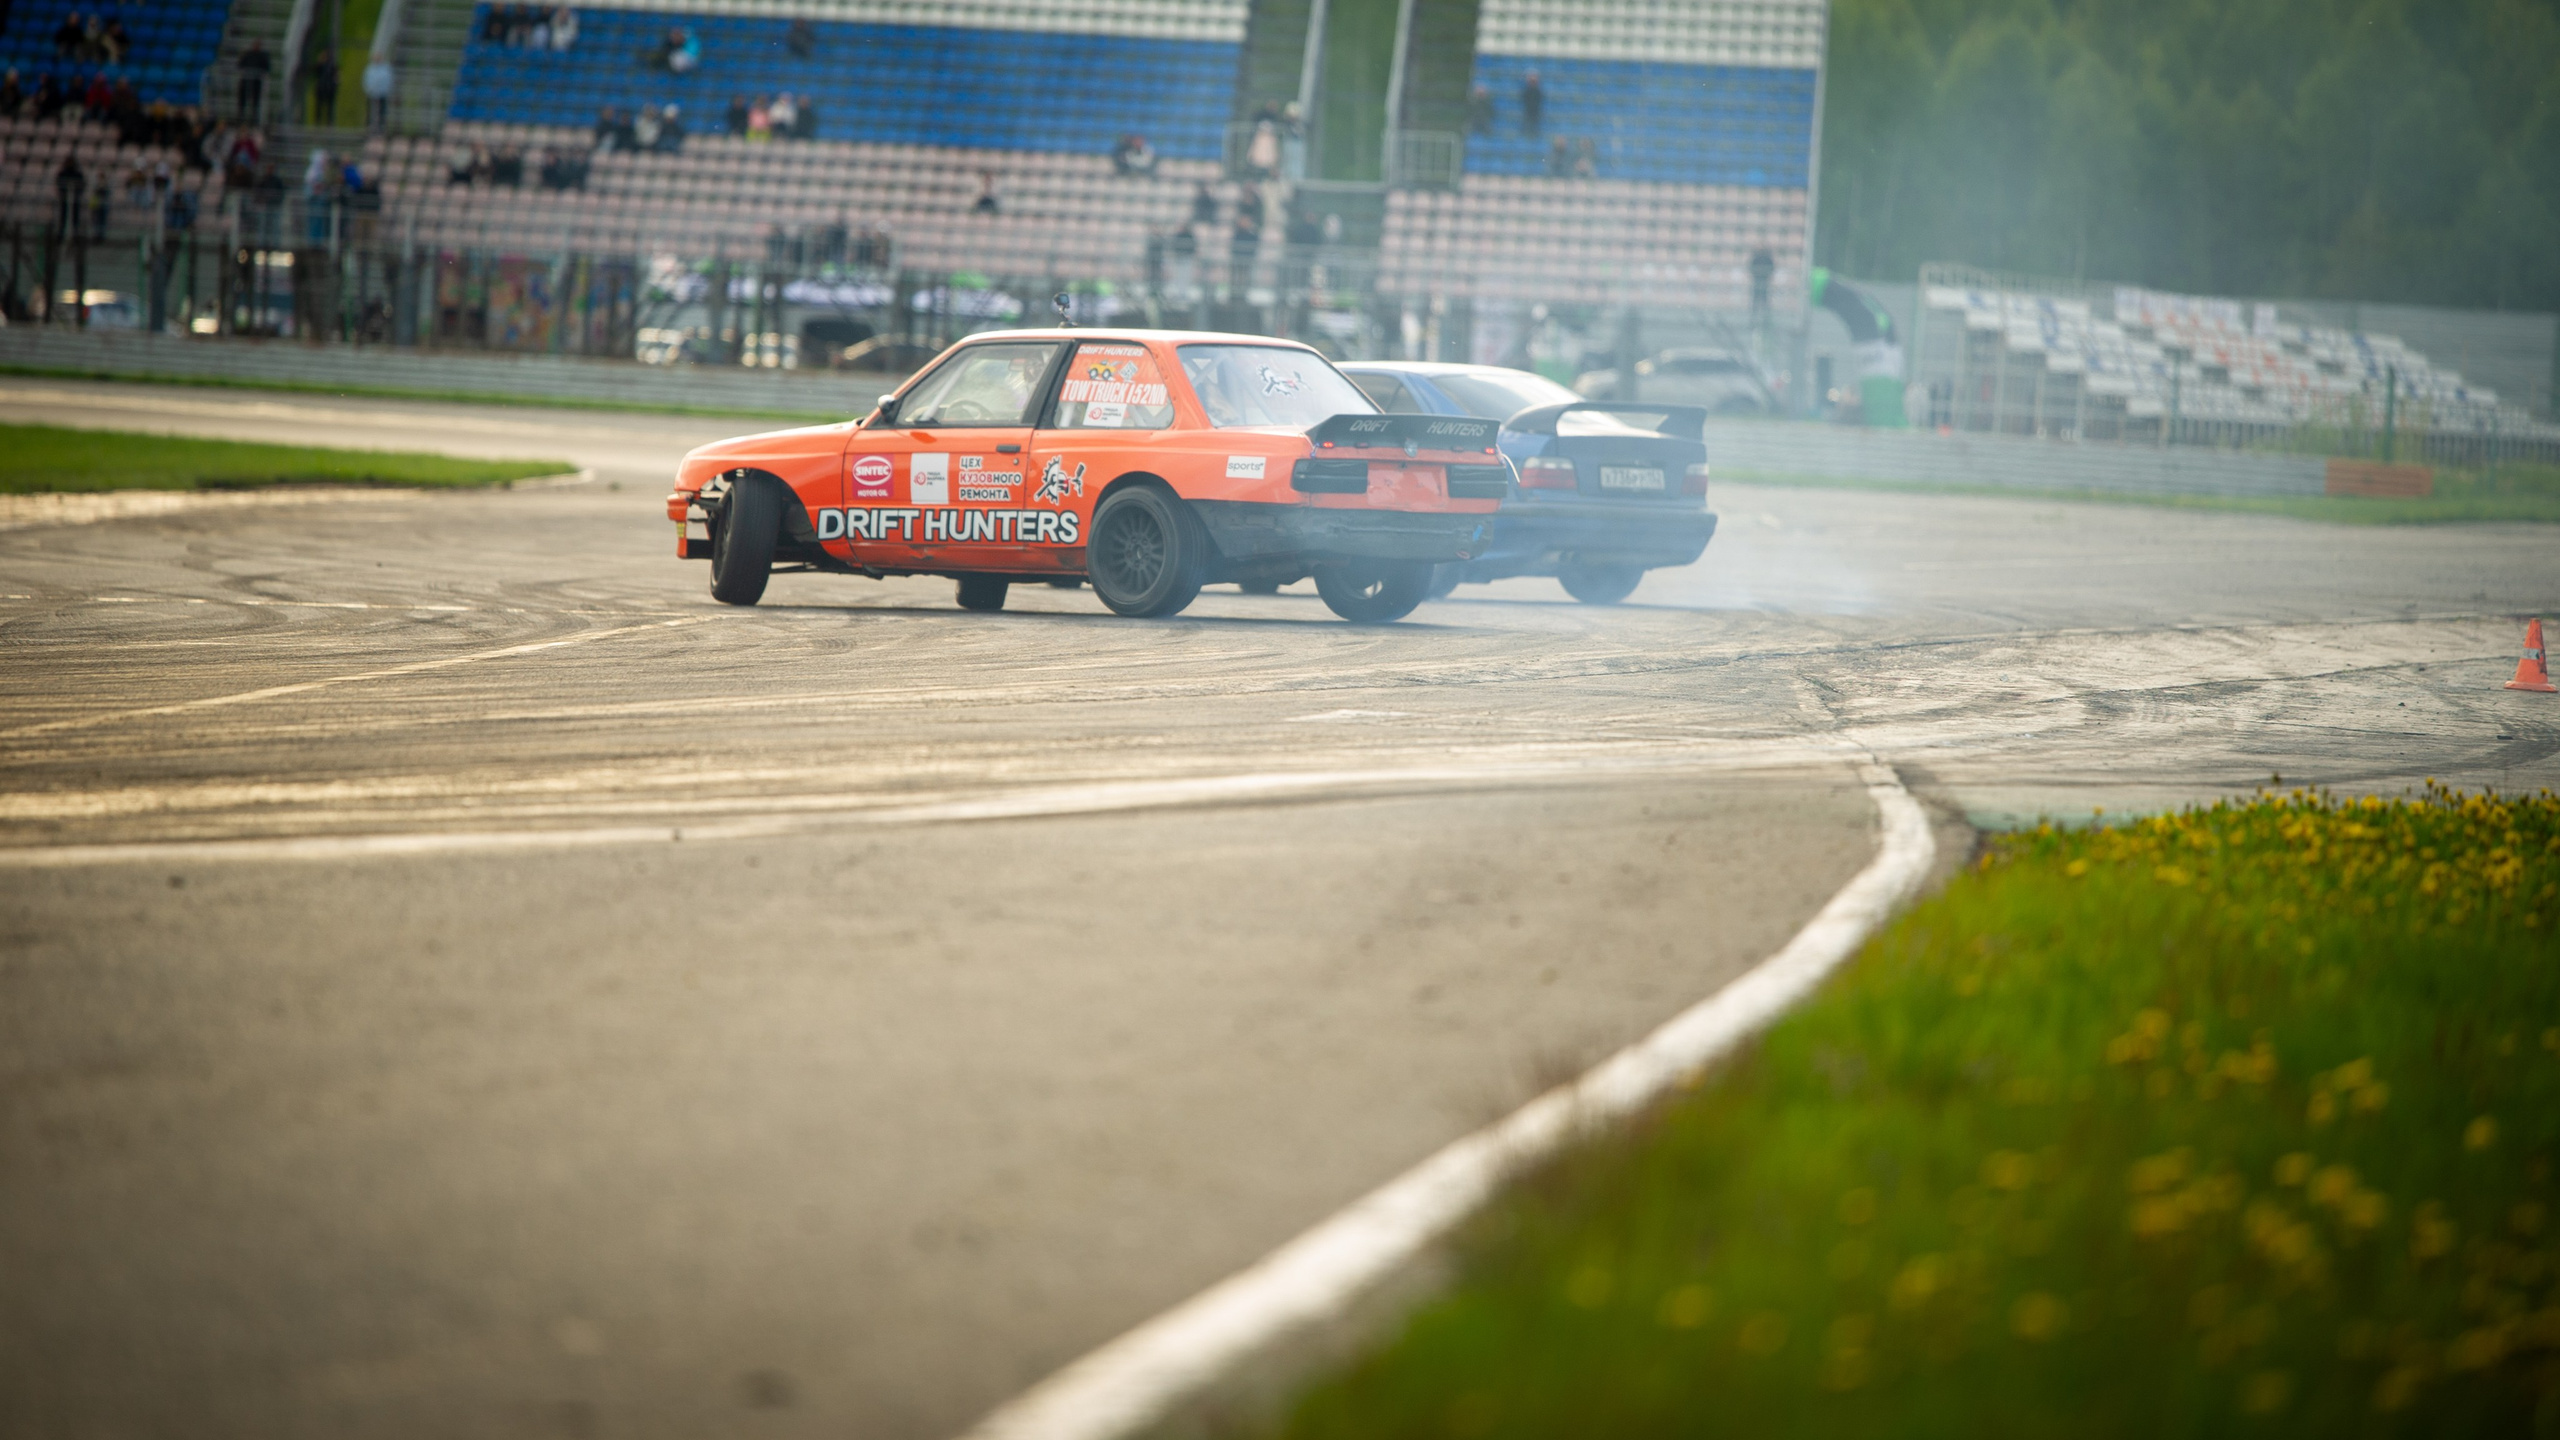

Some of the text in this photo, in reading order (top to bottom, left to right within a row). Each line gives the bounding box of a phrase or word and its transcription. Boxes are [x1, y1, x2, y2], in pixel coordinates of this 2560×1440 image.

[1078, 346, 1145, 357] DRIFT HUNTERS
[1350, 419, 1487, 437] DRIFT HUNTERS
[960, 457, 982, 469] ЦЕХ
[855, 465, 889, 477] SINTEC
[960, 473, 1021, 484] КУЗОВНОГО
[857, 489, 878, 497] MOTOR
[960, 488, 1010, 500] РЕМОНТА
[817, 508, 1079, 544] DRIFT HUNTERS
